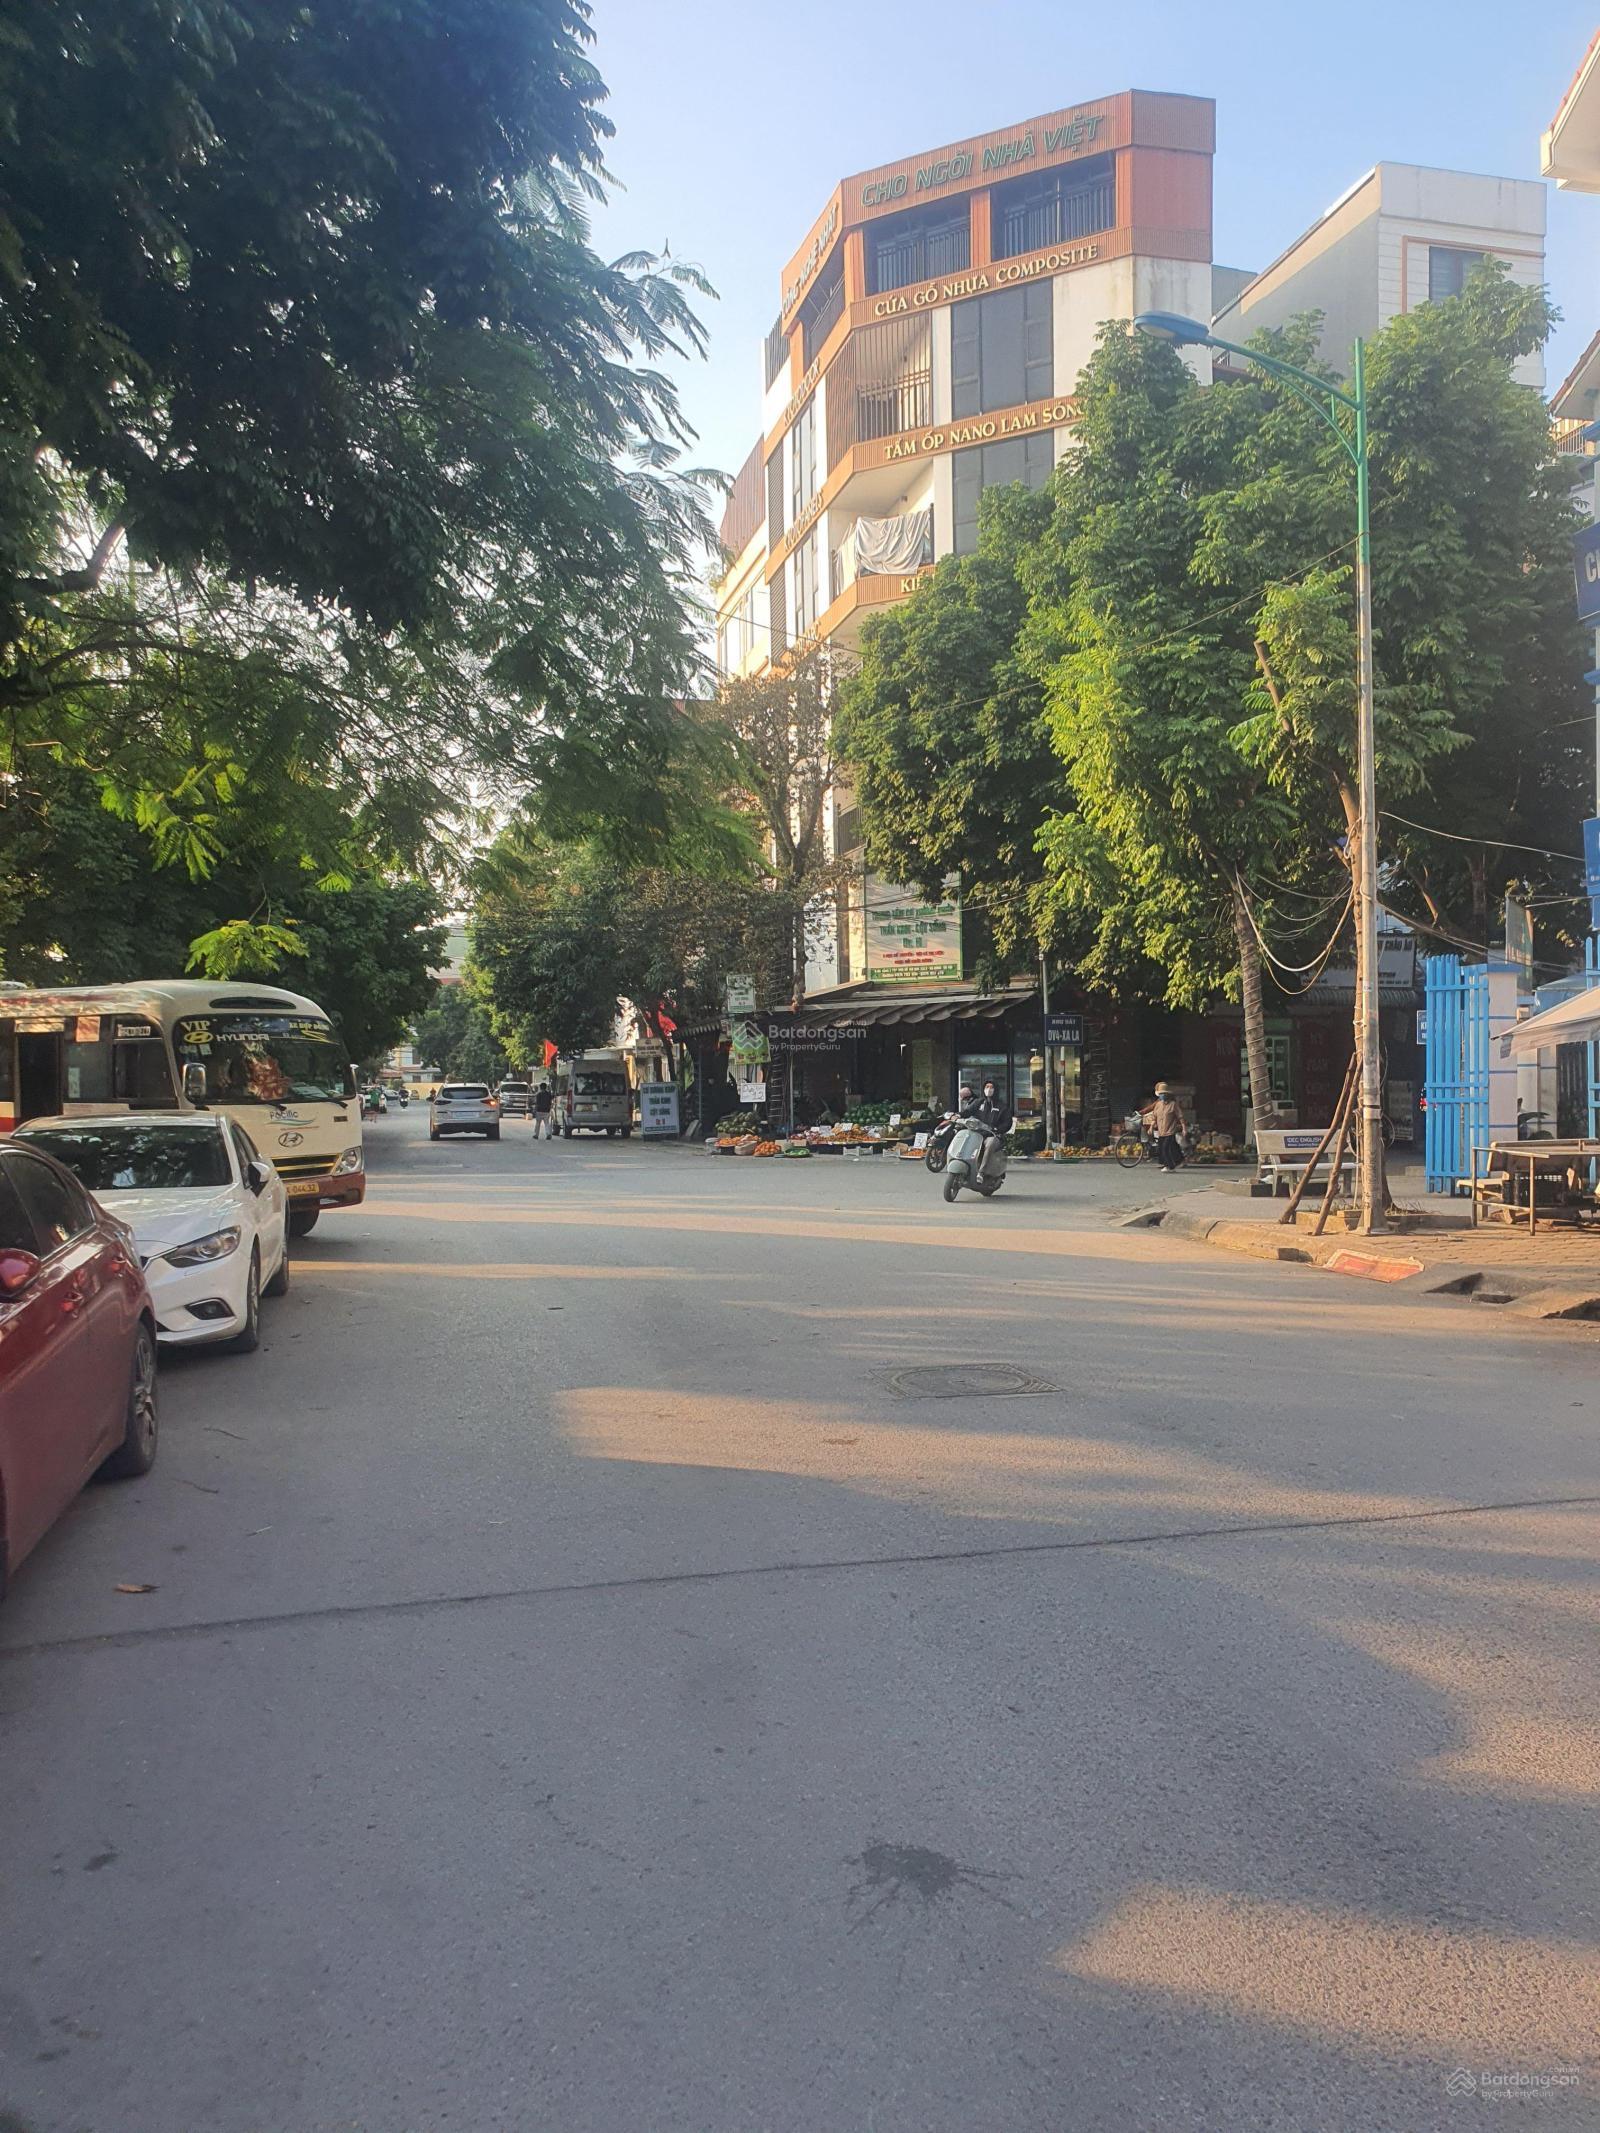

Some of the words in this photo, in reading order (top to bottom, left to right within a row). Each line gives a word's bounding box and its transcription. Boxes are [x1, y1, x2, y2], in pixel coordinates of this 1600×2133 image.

[861, 174, 908, 208] CHO
[1043, 112, 1105, 153] VIỆT
[913, 280, 939, 307] GỖ
[943, 274, 989, 300] NHỰA
[995, 244, 1098, 284] COMPOSITE
[884, 437, 916, 460] TẤM
[921, 429, 944, 451] ỐP
[950, 420, 996, 445] NANO
[1000, 411, 1037, 434] LAM
[180, 1020, 211, 1032] VIP
[216, 1033, 270, 1042] HYUNDAI
